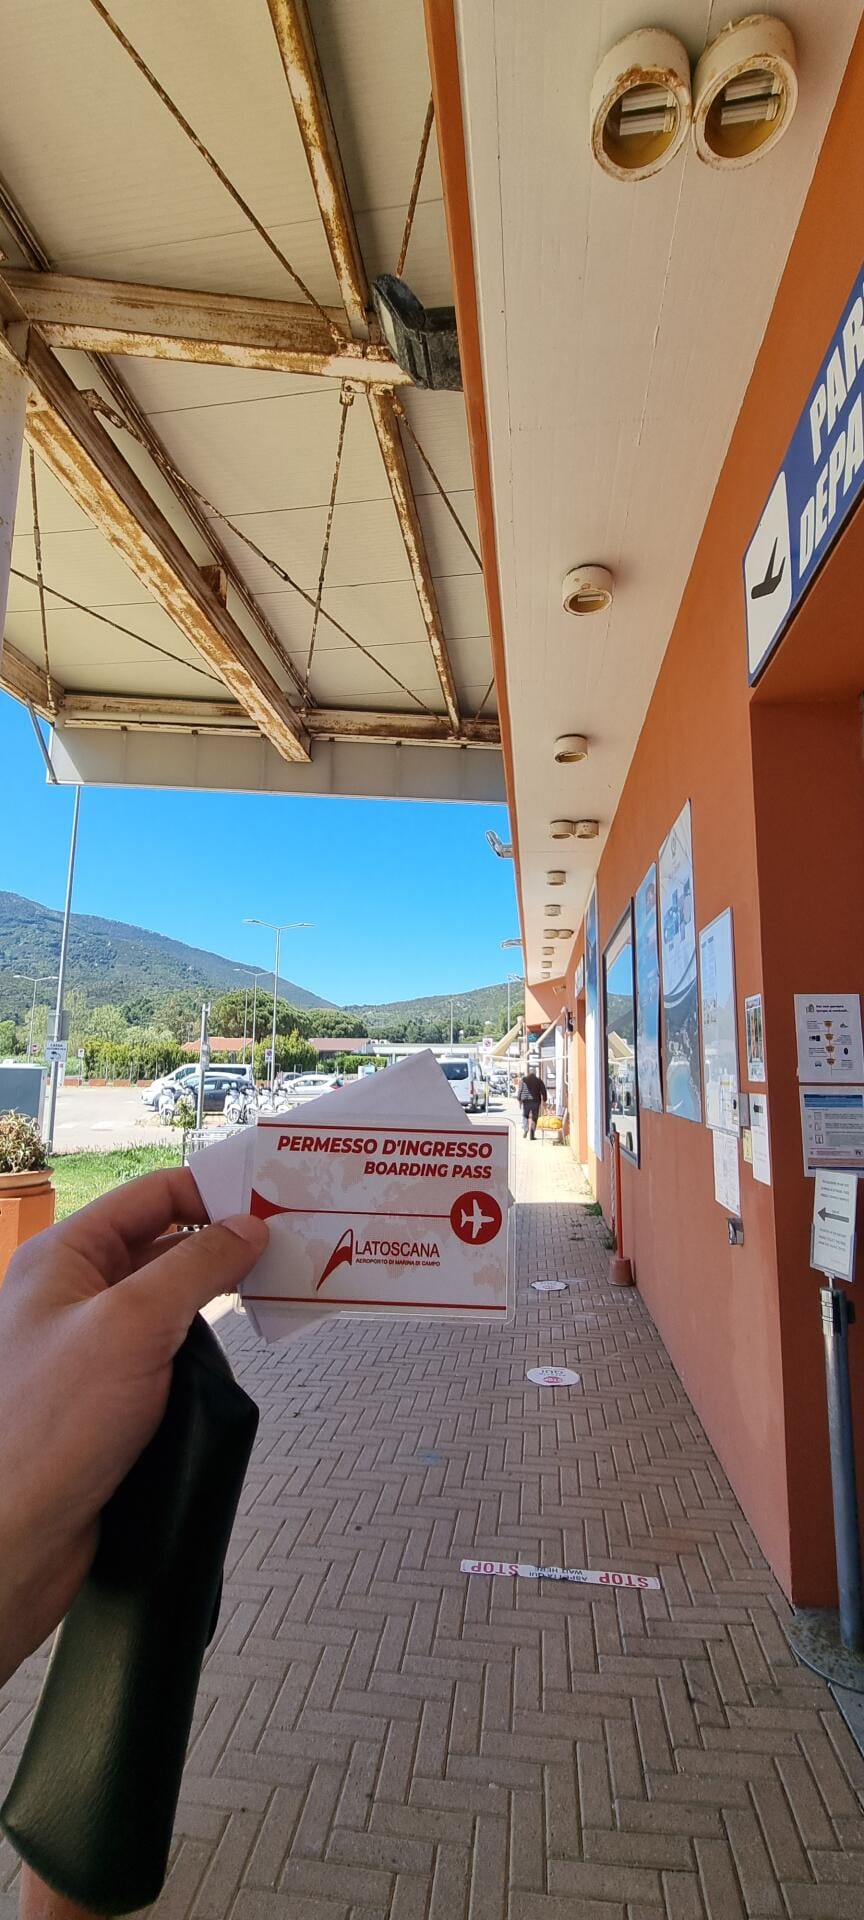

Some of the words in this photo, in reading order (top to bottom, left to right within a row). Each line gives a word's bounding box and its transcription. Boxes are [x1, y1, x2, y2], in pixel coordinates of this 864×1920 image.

[810, 282, 864, 465] PAR
[277, 1135, 378, 1155] PERMESSO
[382, 1139, 493, 1158] D'INGRESSO
[364, 1161, 448, 1178] BOARDING
[452, 1164, 492, 1179] PASS
[471, 1562, 519, 1576] STOP
[562, 1568, 583, 1576] WAIT
[598, 1572, 649, 1588] STOP
